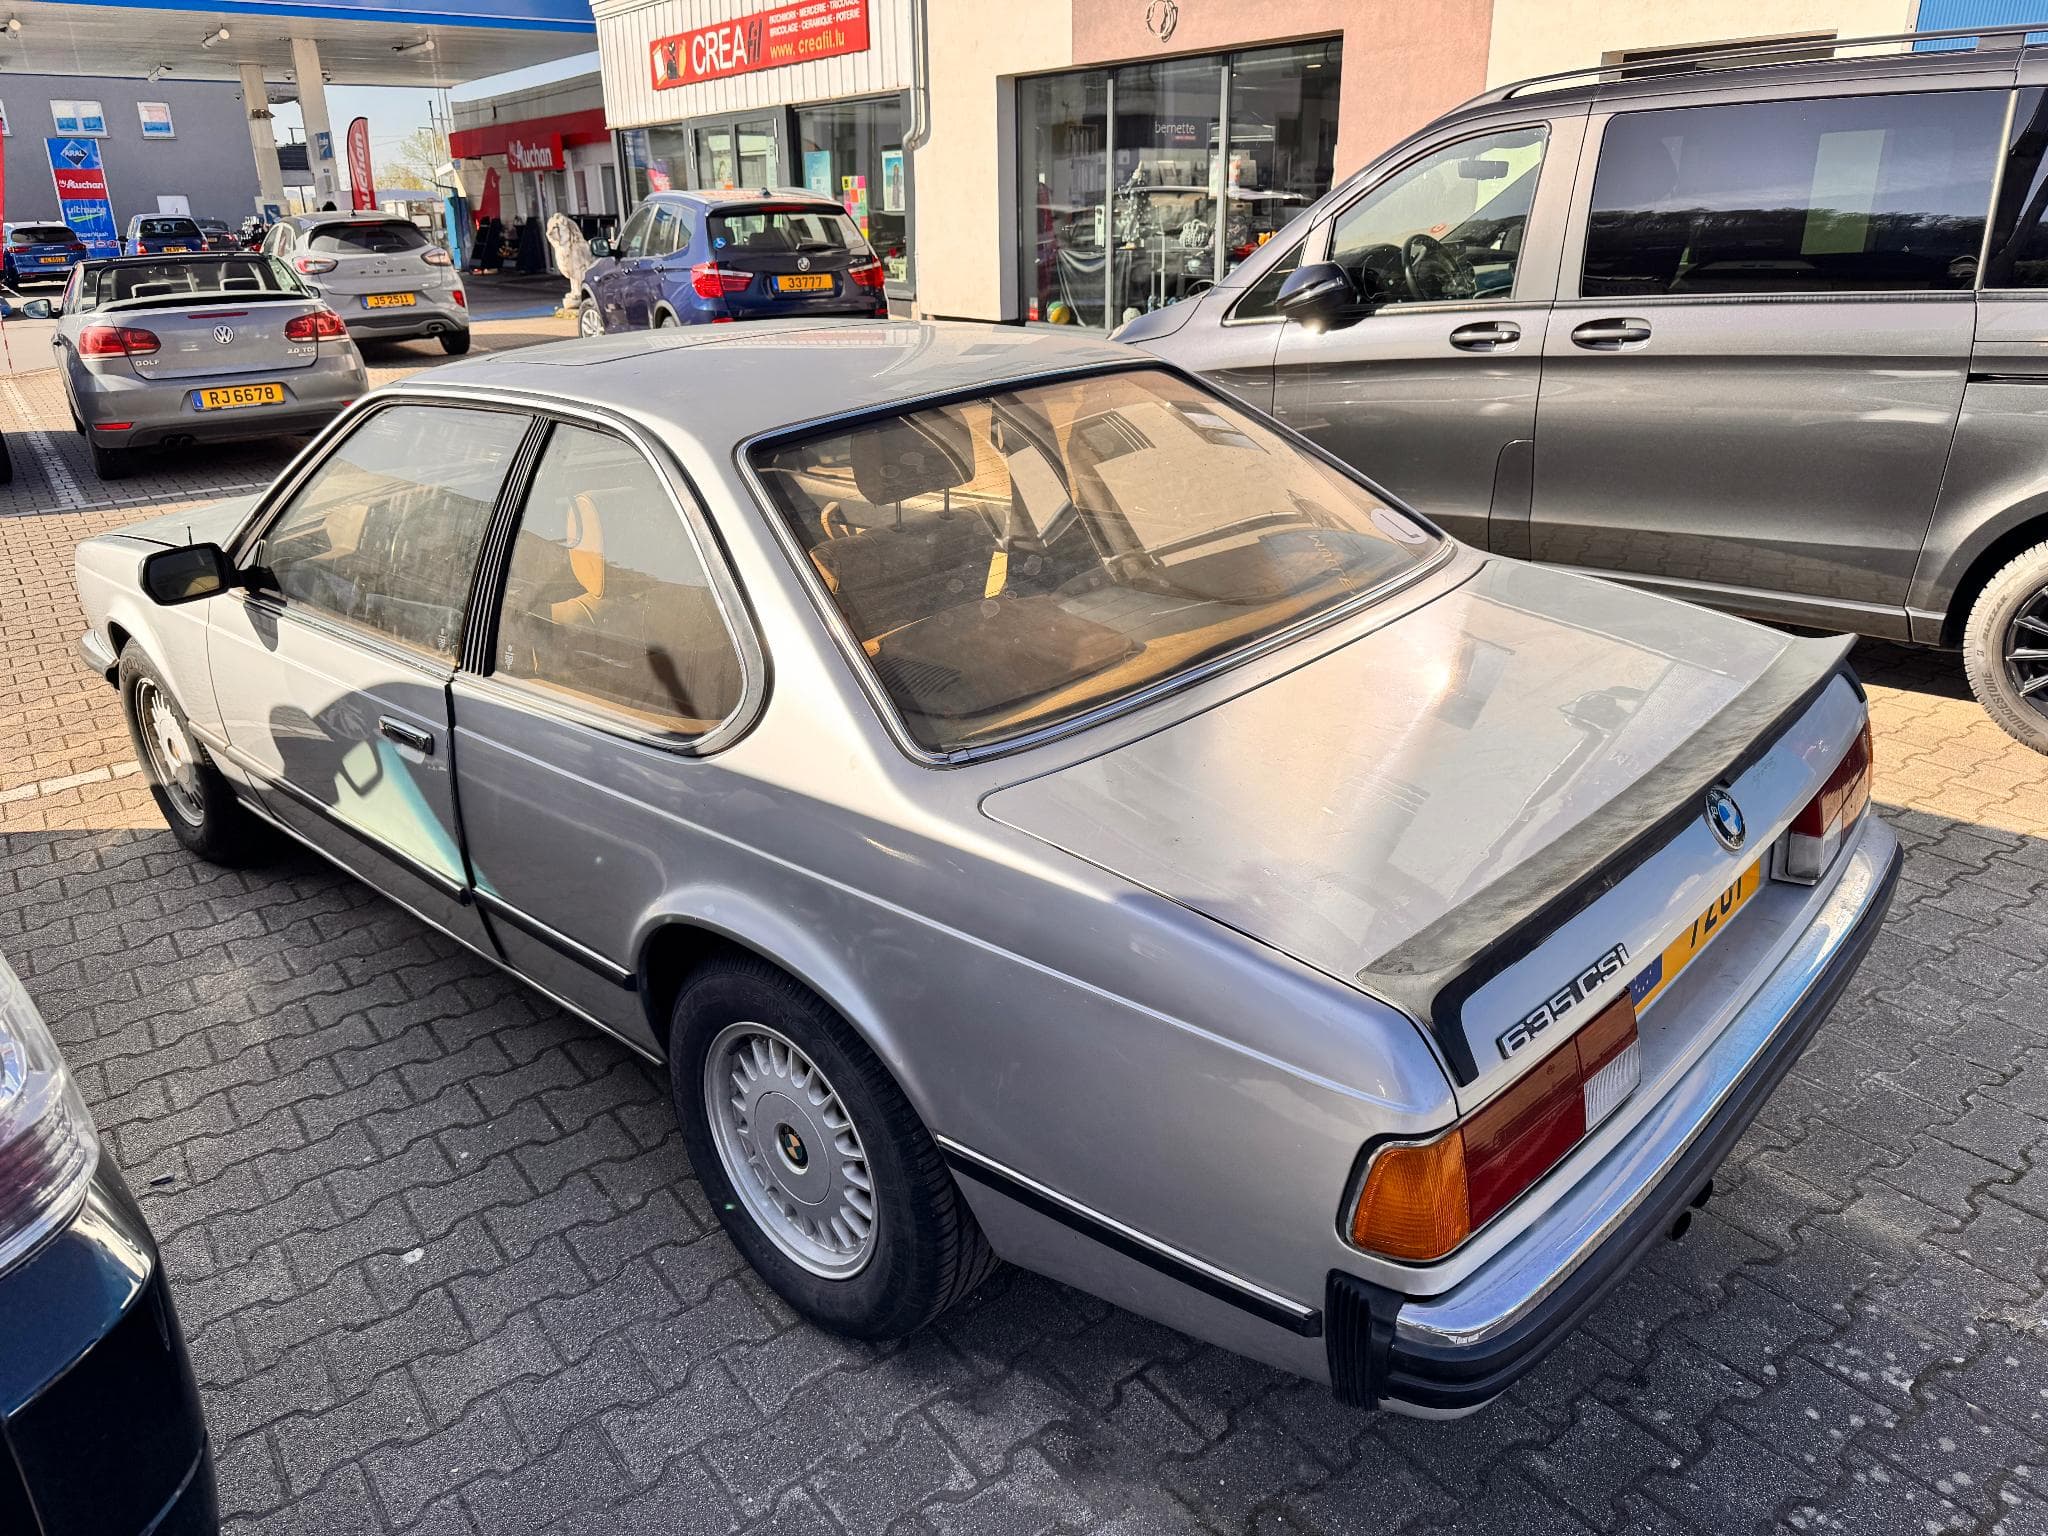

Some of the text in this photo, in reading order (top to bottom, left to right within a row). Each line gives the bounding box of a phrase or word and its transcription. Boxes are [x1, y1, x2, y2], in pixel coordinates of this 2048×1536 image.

[1154, 119, 1196, 134] bernette
[66, 179, 104, 189] Auchan
[787, 276, 823, 289] 33777
[374, 294, 409, 305] JS 2511
[135, 359, 160, 367] GOLF
[209, 387, 275, 406] RJ 6678
